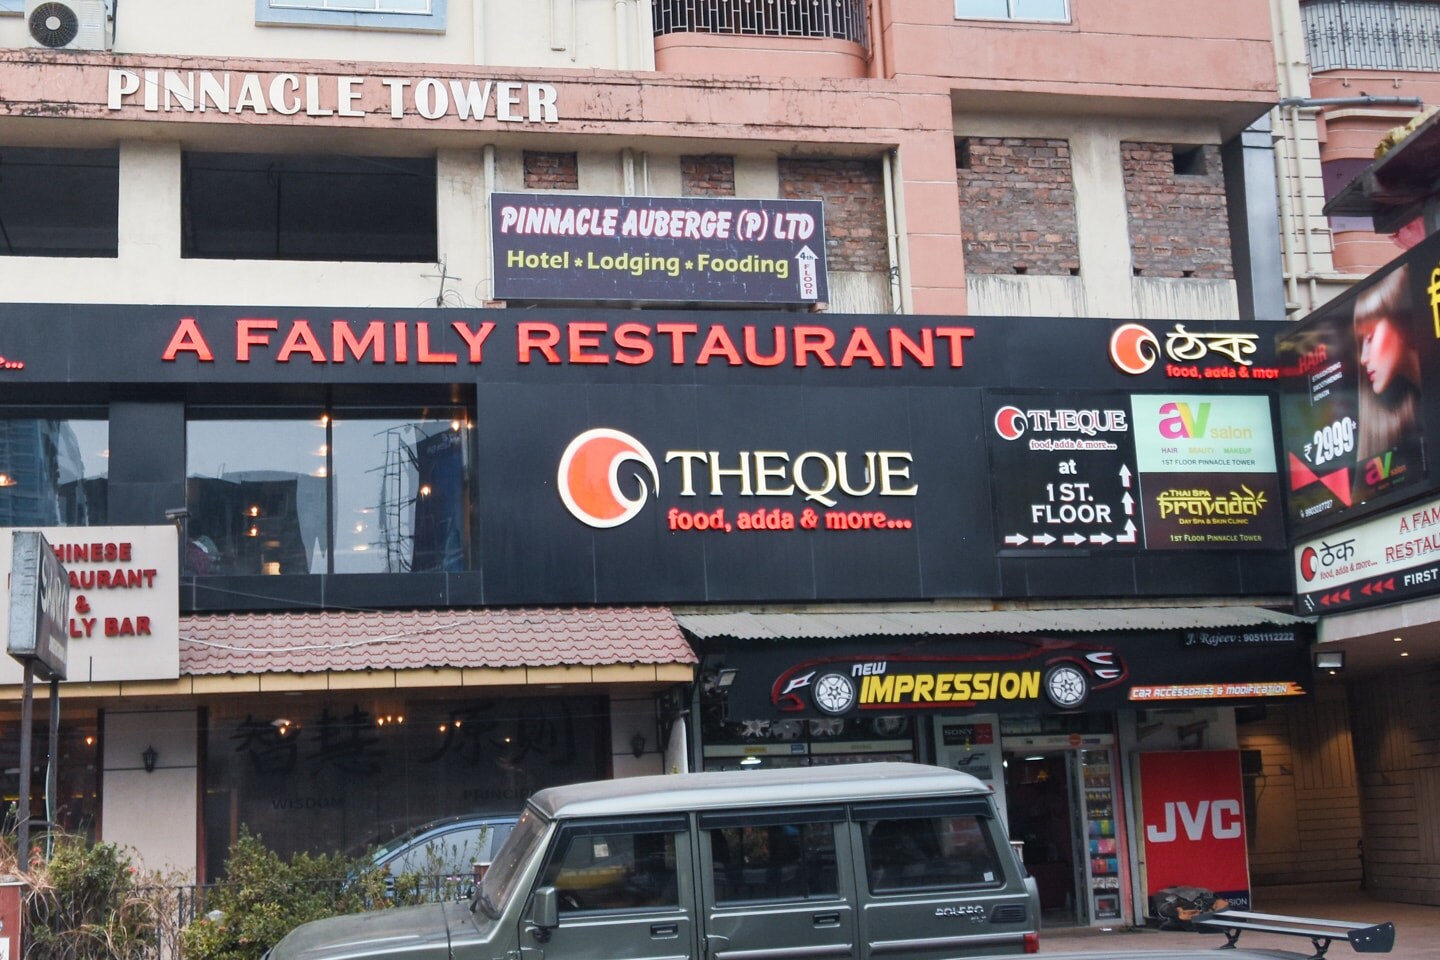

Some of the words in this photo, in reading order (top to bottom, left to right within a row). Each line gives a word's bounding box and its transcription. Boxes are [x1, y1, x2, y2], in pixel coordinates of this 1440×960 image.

[108, 69, 366, 117] PINNACLE
[383, 77, 559, 123] TOWER
[501, 206, 618, 236] PINNACLE
[623, 209, 731, 239] AUBERGE
[736, 210, 768, 241] (P)
[774, 212, 815, 240] LTD
[507, 250, 569, 269] Hotel
[587, 252, 680, 276] Lodging
[697, 254, 788, 278] Fooding
[803, 263, 813, 295] FLOOR
[163, 318, 212, 362] A
[235, 319, 496, 365] FAMILY
[516, 321, 976, 368] RESTAURANT
[1166, 364, 1202, 379] food,
[1204, 365, 1236, 378] adda
[1237, 365, 1250, 378] &
[1027, 410, 1128, 436] THEQUE
[1210, 425, 1252, 439] salon
[1029, 439, 1053, 451] food,
[1054, 439, 1075, 450] adda
[1076, 440, 1084, 450] &
[1059, 459, 1077, 474] at
[664, 451, 919, 508] THEQUE
[668, 507, 732, 533] food,
[737, 508, 795, 530] adda
[800, 508, 819, 530] &
[825, 510, 912, 530] more...
[1031, 505, 1112, 523] FLOOR
[1400, 517, 1409, 533] A
[51, 543, 132, 563] HINESE
[1320, 539, 1355, 566] ठेक
[8, 569, 157, 590] AURANT
[1404, 568, 1439, 586] FIRST
[75, 595, 91, 614] &
[105, 617, 152, 637] BAR
[859, 671, 1040, 703] IMPRESSION
[1154, 687, 1214, 697] ACCESSORIES
[1216, 687, 1223, 695] &
[272, 797, 345, 810] WISDOM
[1147, 799, 1241, 843] JVC
